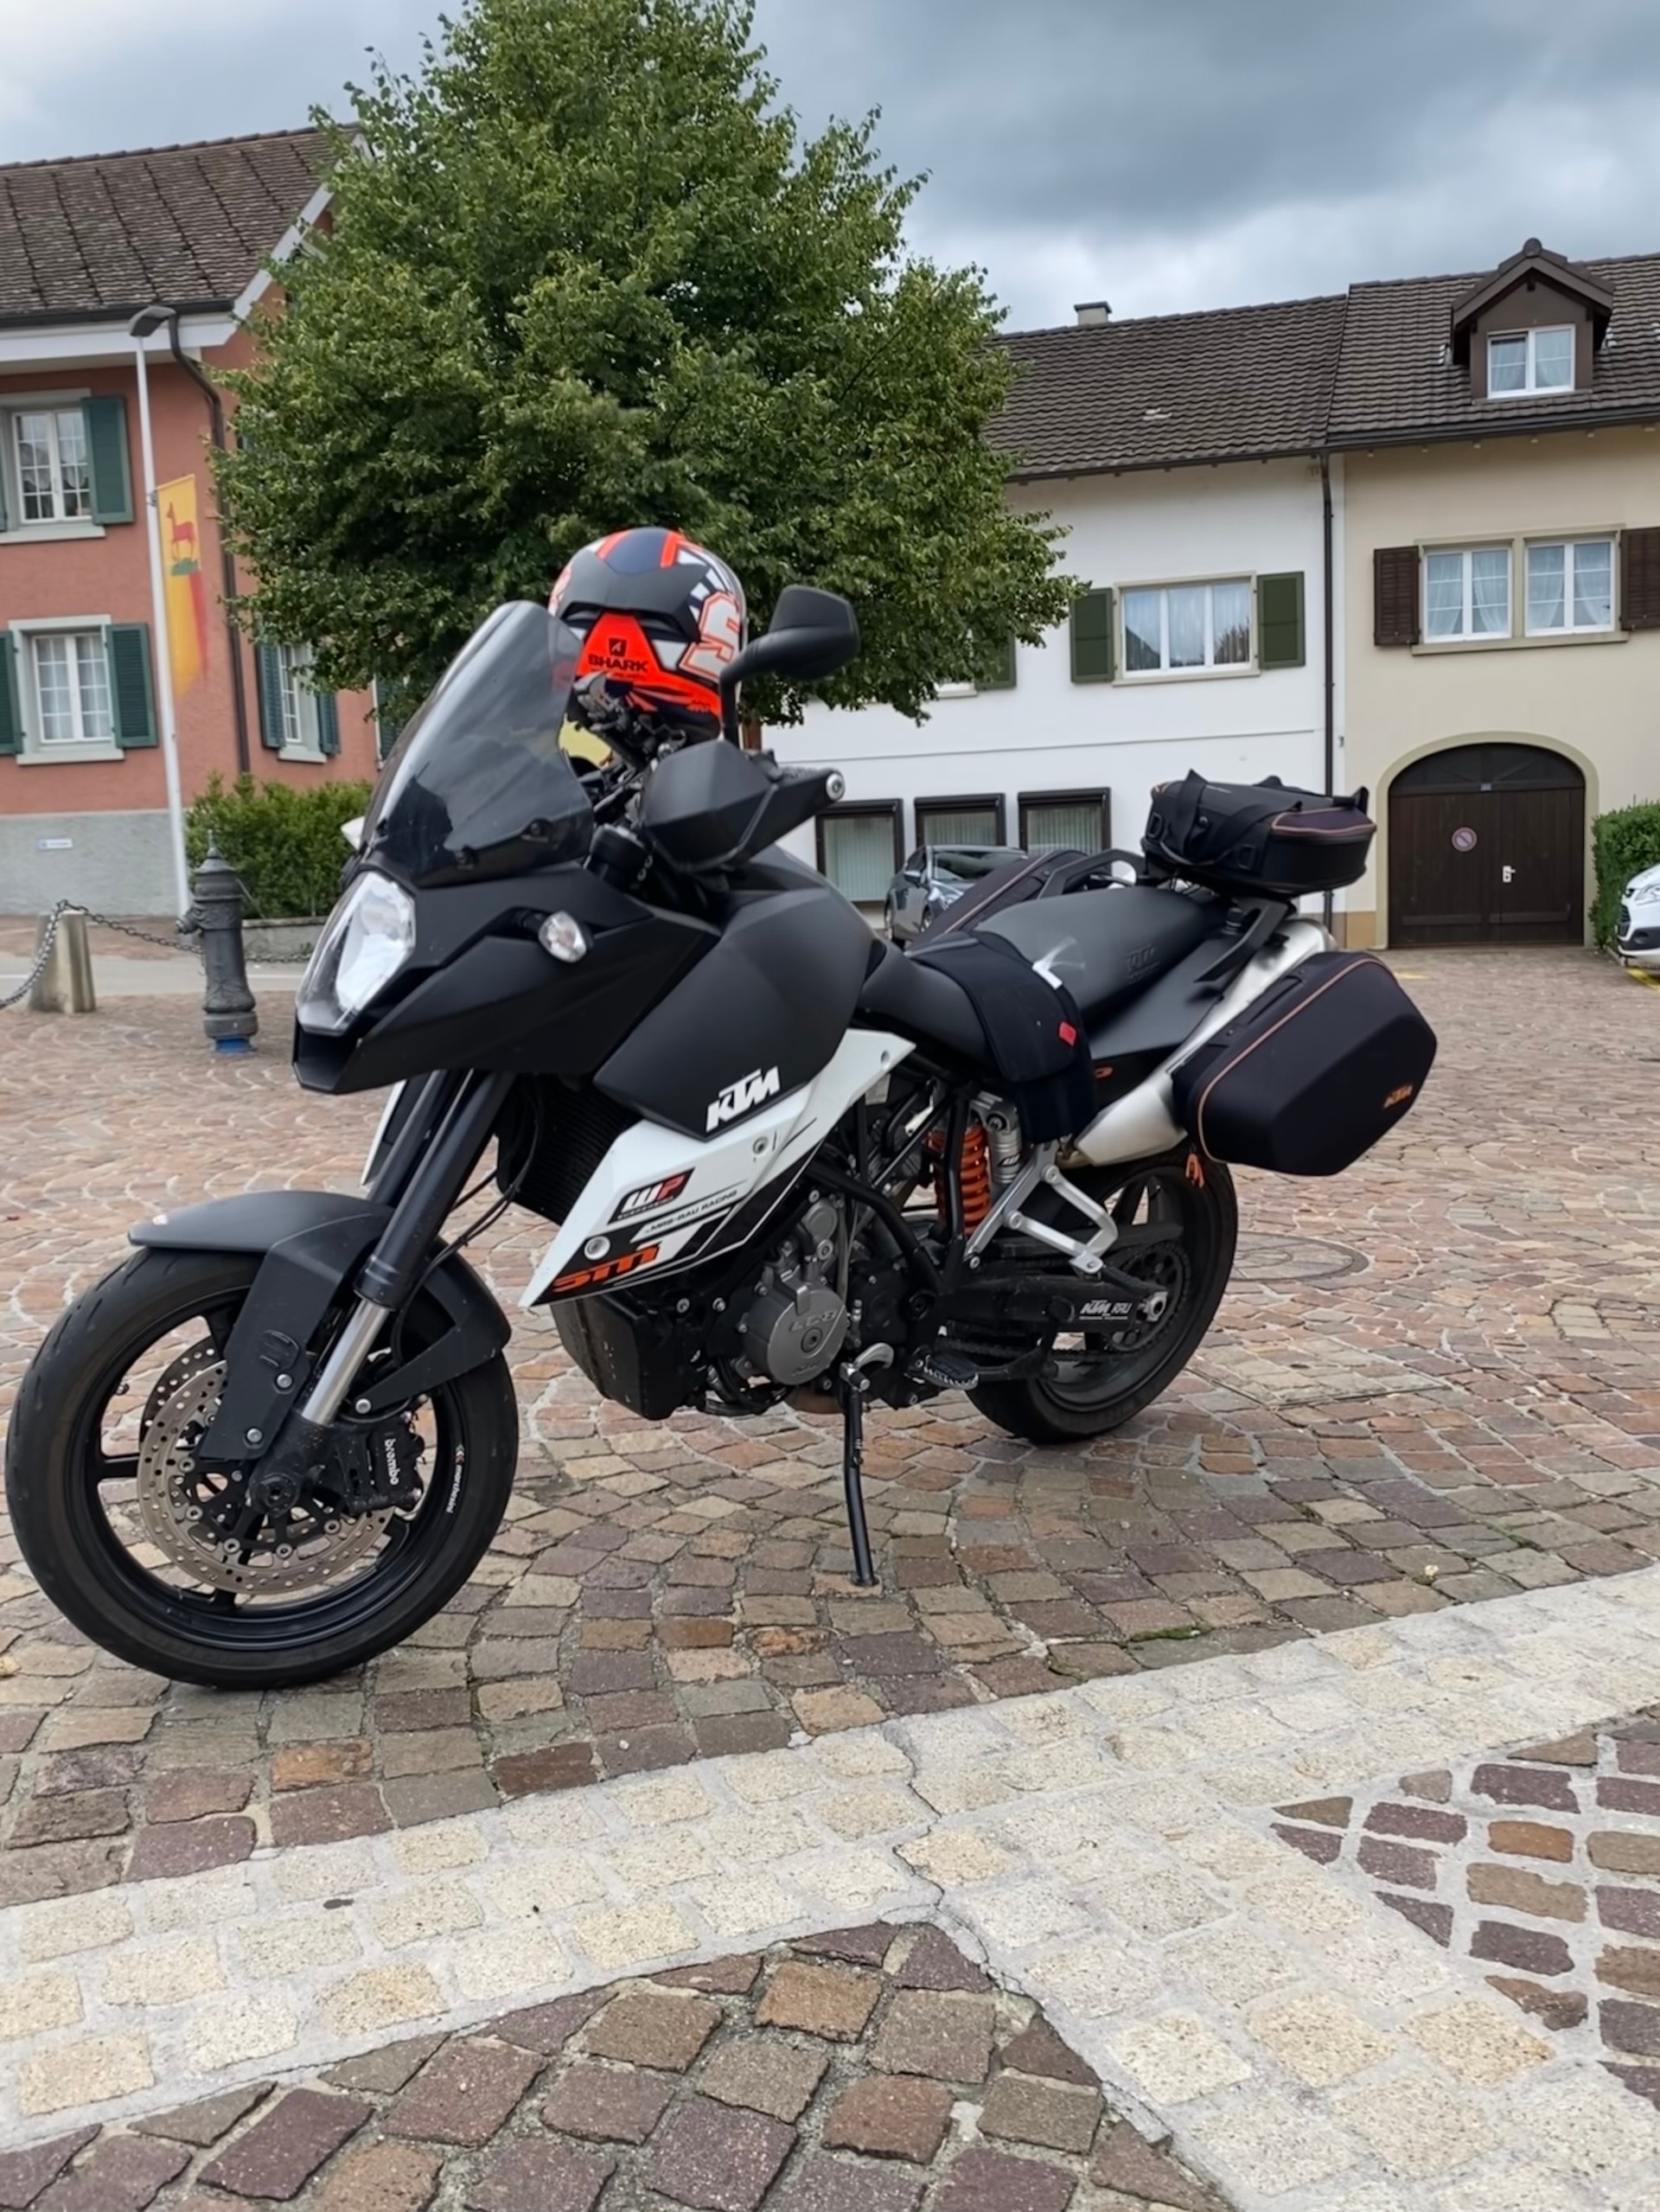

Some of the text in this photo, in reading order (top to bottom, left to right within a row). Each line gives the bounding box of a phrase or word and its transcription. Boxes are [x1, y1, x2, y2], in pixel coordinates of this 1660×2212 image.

[588, 654, 648, 673] SHARK
[706, 1065, 781, 1132] KTM
[1383, 1084, 1414, 1109] KTM
[620, 1173, 686, 1213] WP
[1080, 1300, 1112, 1314] KTM
[384, 1437, 400, 1486] brembo
